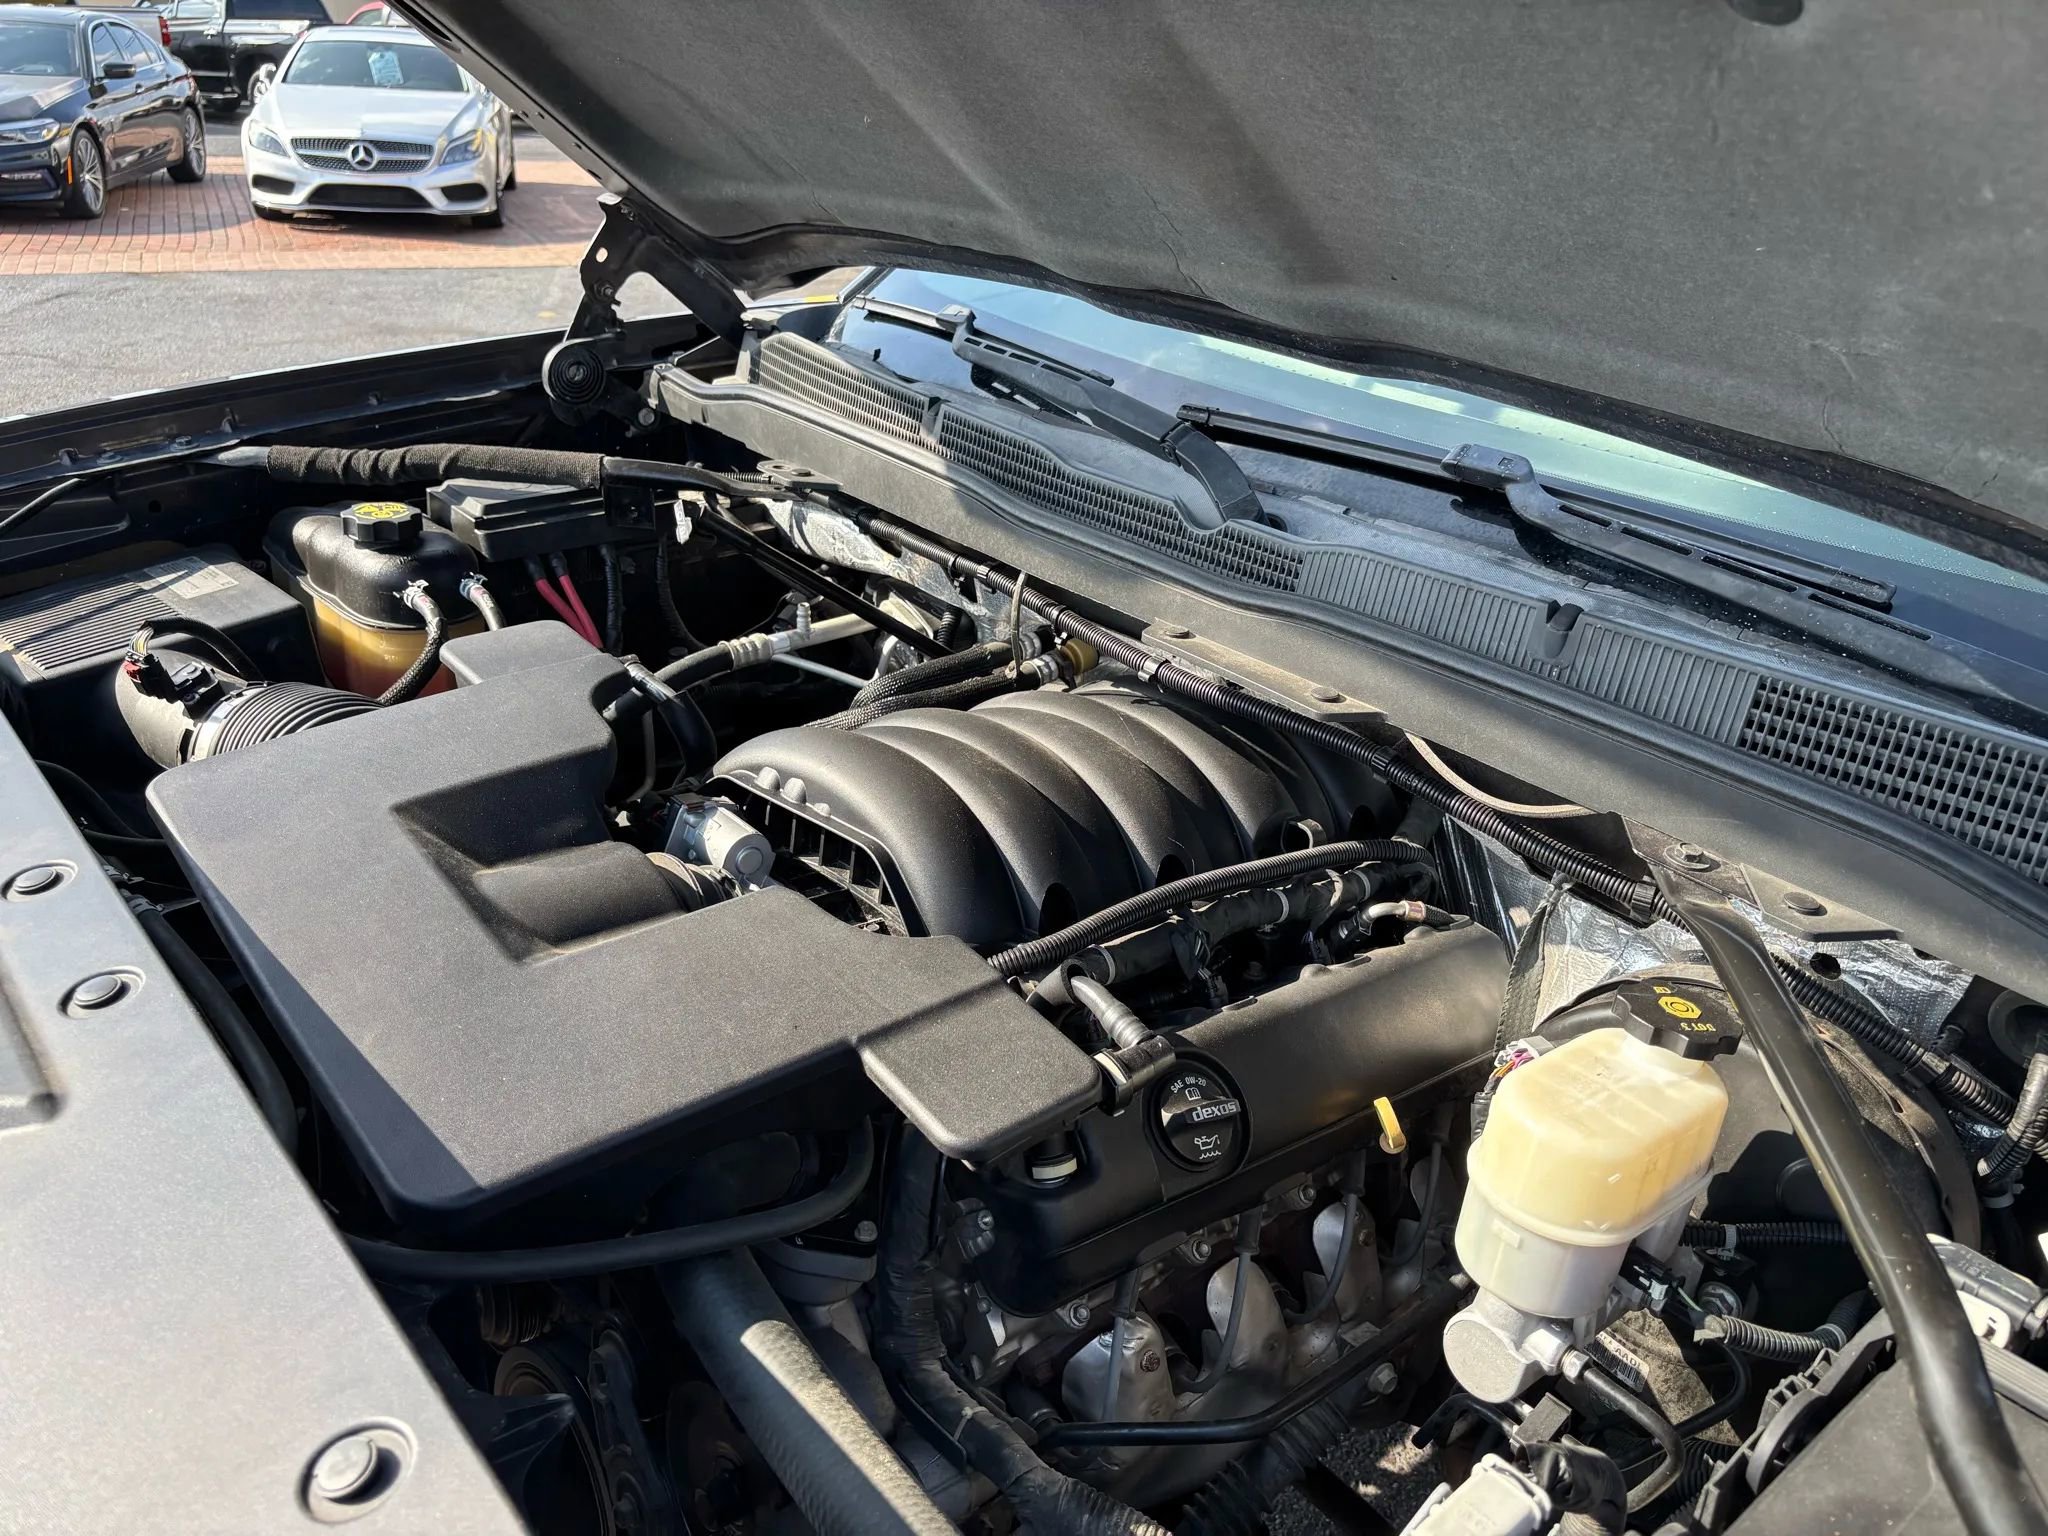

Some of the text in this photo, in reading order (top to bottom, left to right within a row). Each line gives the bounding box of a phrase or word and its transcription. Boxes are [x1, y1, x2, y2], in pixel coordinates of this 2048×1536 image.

[1680, 1022, 1717, 1032] DOT 3
[1170, 1076, 1207, 1094] SAE 0W-20
[1192, 1101, 1238, 1122] dexos
